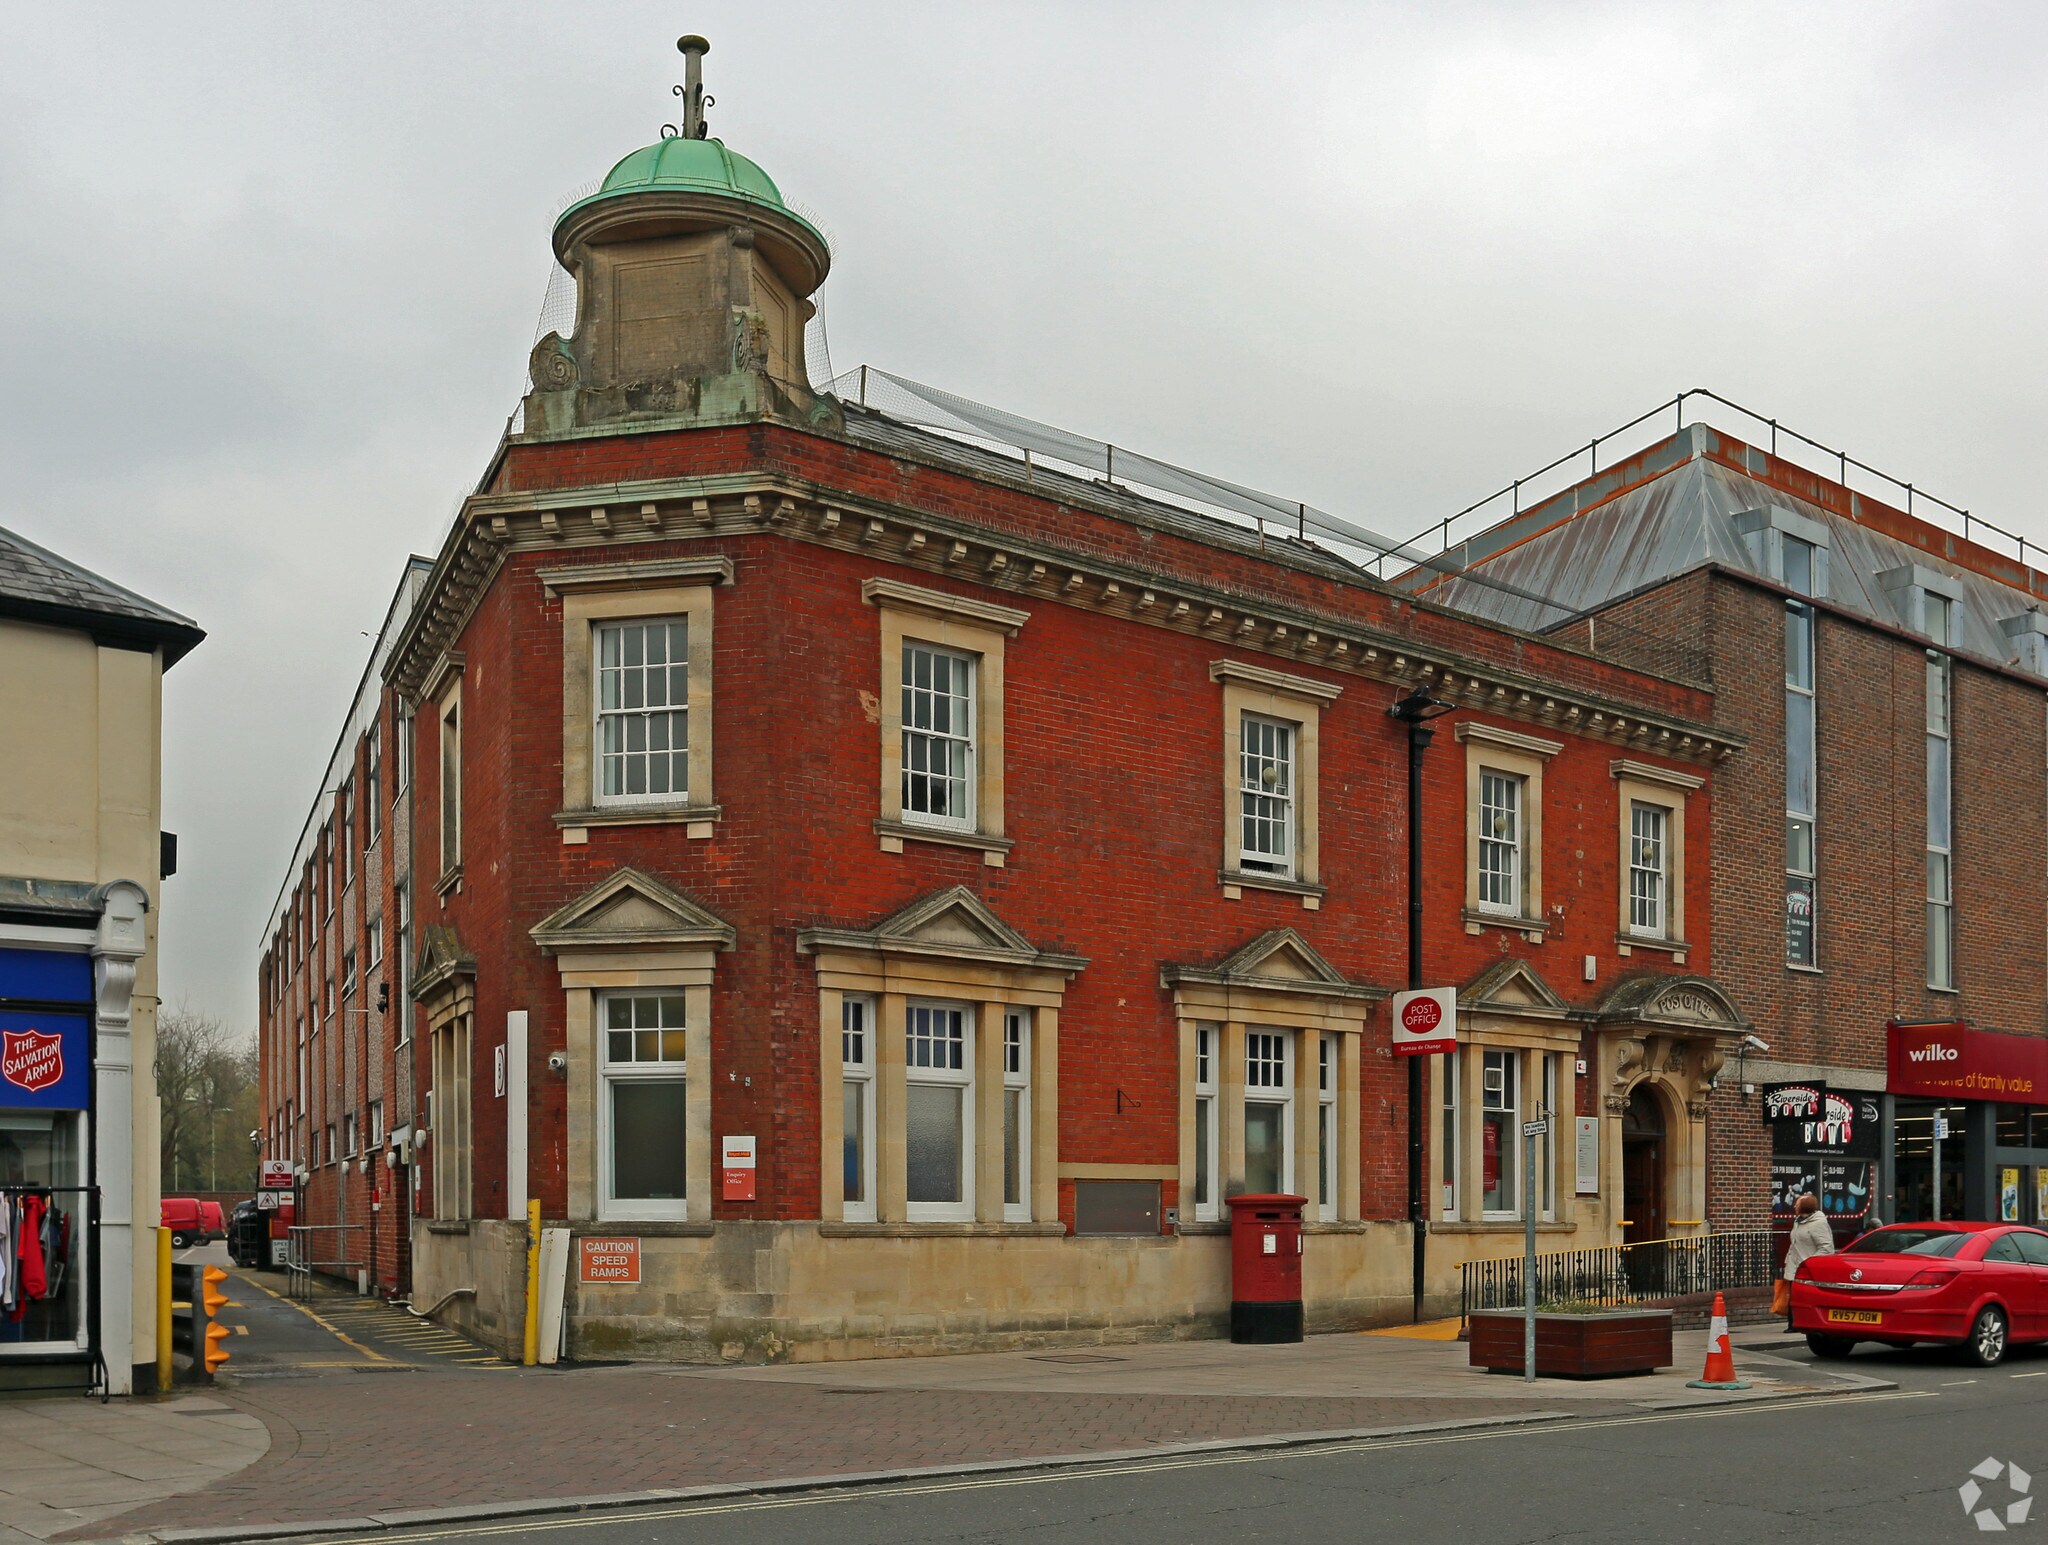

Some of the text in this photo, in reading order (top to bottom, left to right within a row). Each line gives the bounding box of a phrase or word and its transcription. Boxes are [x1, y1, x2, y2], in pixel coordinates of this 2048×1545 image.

[1411, 1004, 1434, 1015] POST
[1683, 994, 1712, 1020] OFFICE
[1405, 1014, 1437, 1026] OFFICE
[14, 1036, 37, 1054] THE
[5, 1040, 58, 1075] SALVATION
[1909, 1044, 1958, 1062] wilko
[24, 1057, 56, 1083] ARMY
[1965, 1072, 1976, 1088] of
[1977, 1072, 2006, 1094] family
[2007, 1077, 2033, 1093] value
[1770, 1093, 1813, 1104] Riverside
[1770, 1102, 1814, 1118] BOWL
[1804, 1122, 1848, 1145] BOWL
[585, 1242, 634, 1252] CAUTION
[278, 1253, 287, 1263] 5
[592, 1255, 628, 1266] SPEED
[590, 1267, 629, 1278] RAMPS
[1832, 1311, 1857, 1321] RV57
